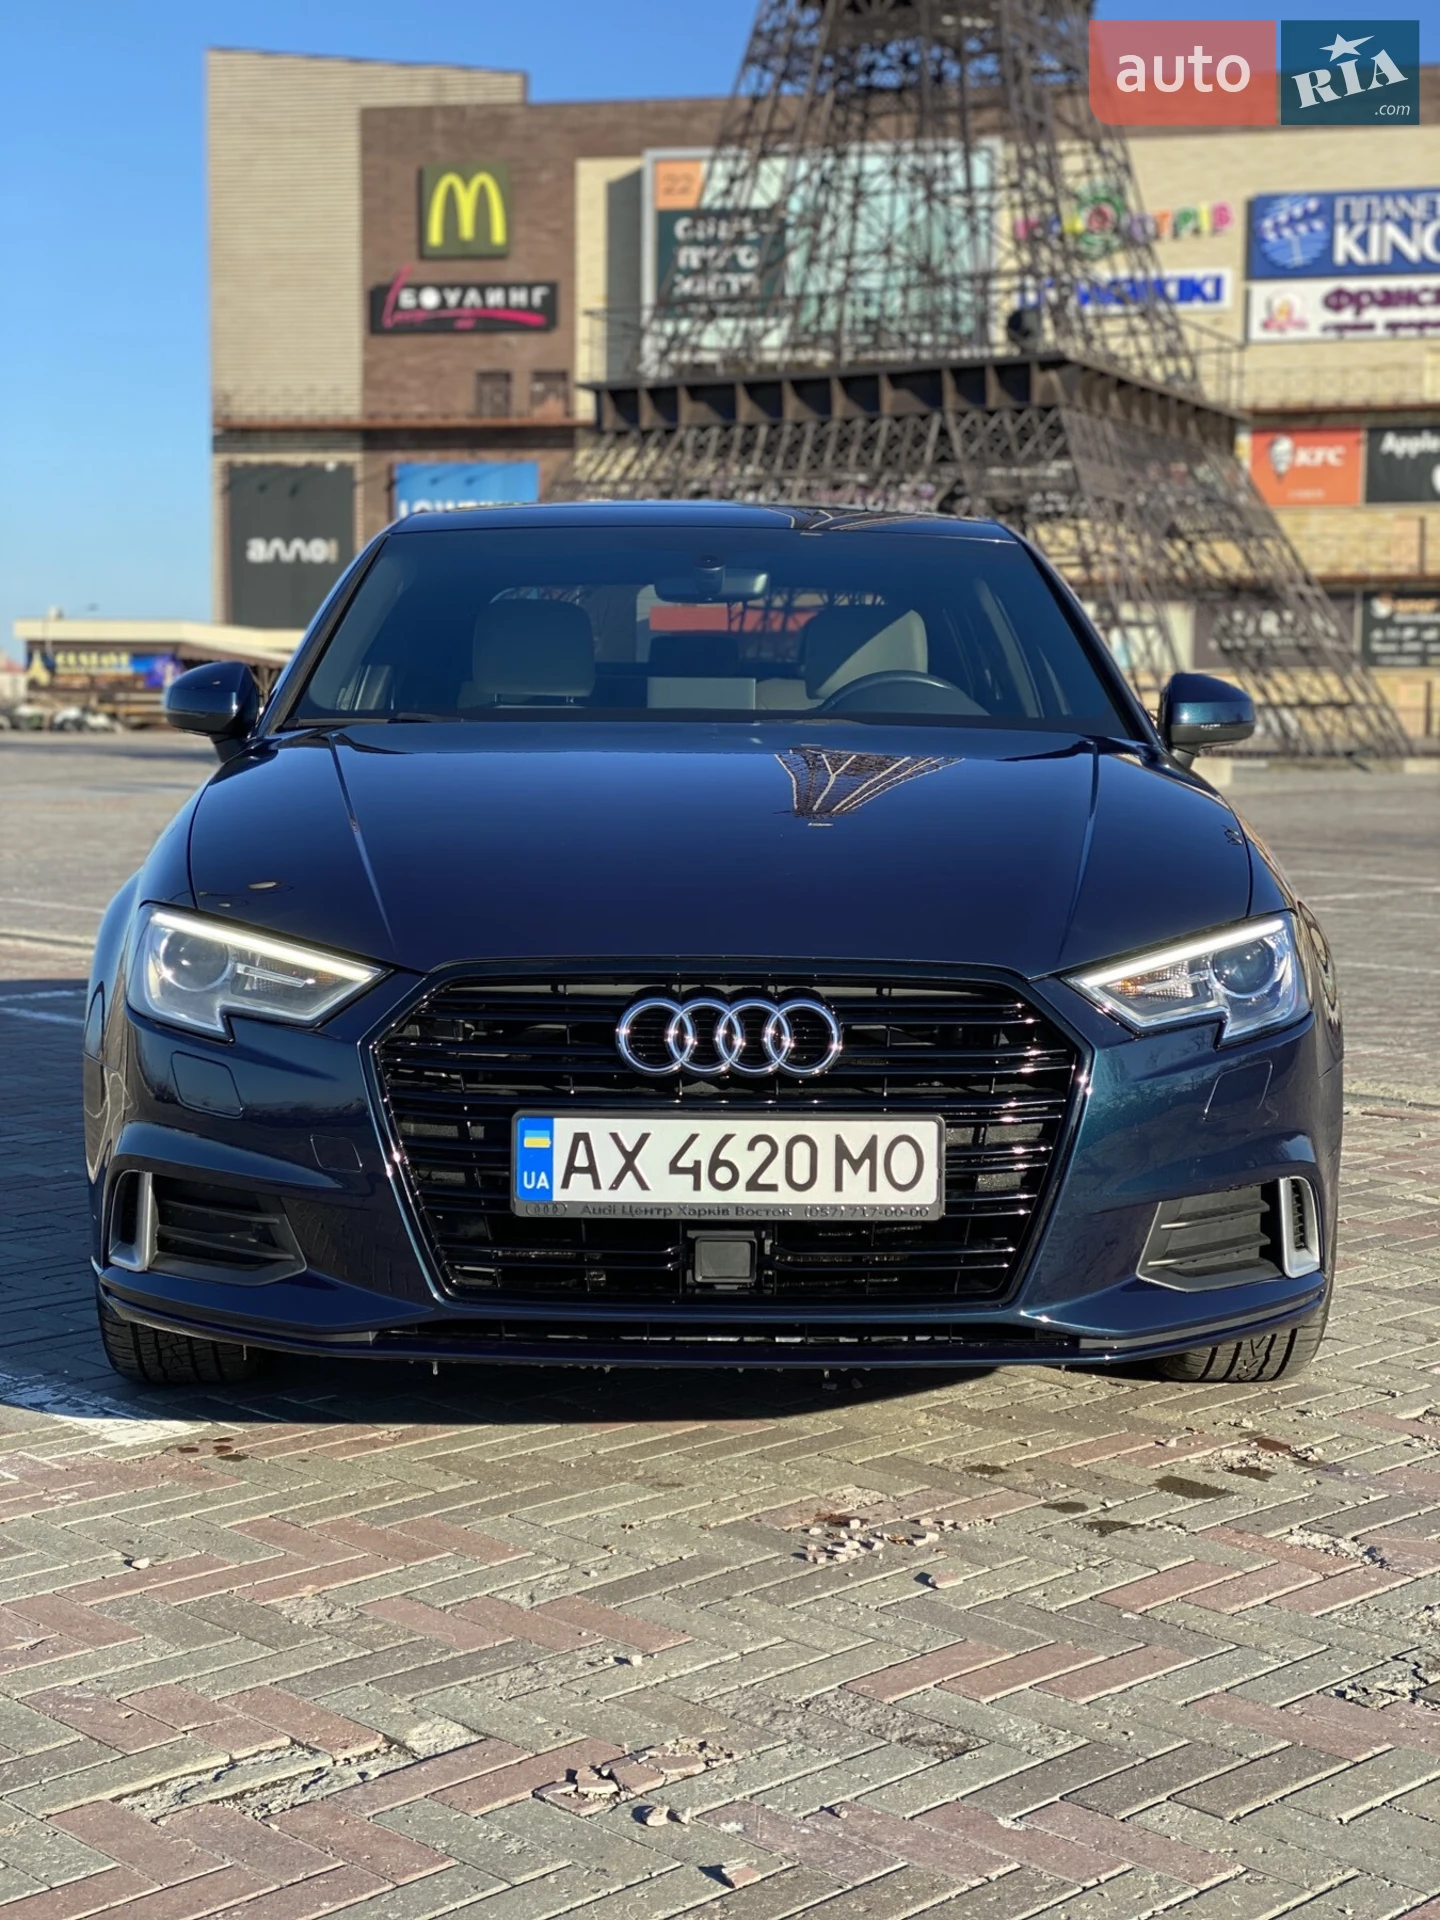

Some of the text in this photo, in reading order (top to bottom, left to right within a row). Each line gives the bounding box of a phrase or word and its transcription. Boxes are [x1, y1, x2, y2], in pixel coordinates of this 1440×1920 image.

[1294, 445, 1346, 467] KFC
[560, 1132, 925, 1192] AX 4620 MO
[523, 1171, 550, 1190] UA
[580, 1204, 616, 1216] Audi
[621, 1205, 673, 1218] Центр
[677, 1205, 730, 1218] Харків
[734, 1206, 793, 1217] Восток
